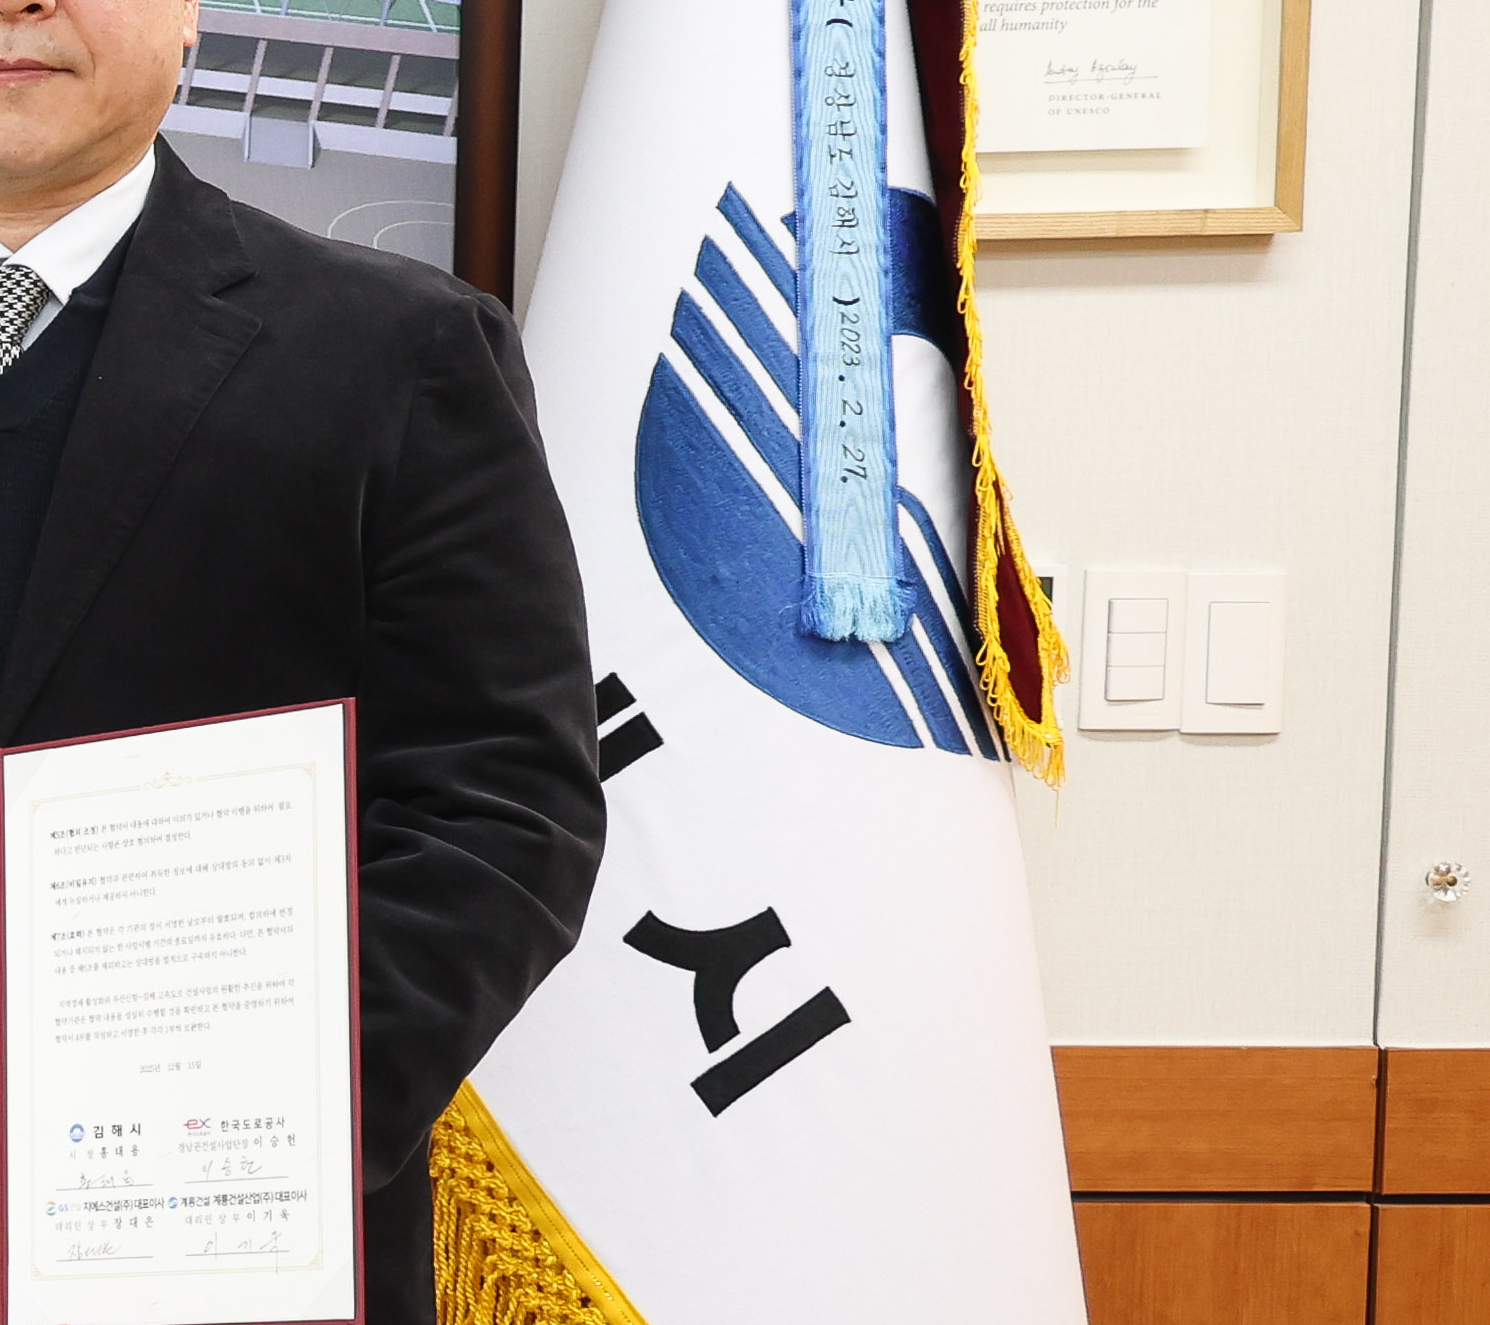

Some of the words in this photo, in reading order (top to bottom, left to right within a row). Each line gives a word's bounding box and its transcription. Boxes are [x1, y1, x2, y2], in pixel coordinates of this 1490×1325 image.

[979, 18, 997, 32] all
[1000, 17, 1068, 34] humanity
[220, 1116, 286, 1131] 한국도로공사
